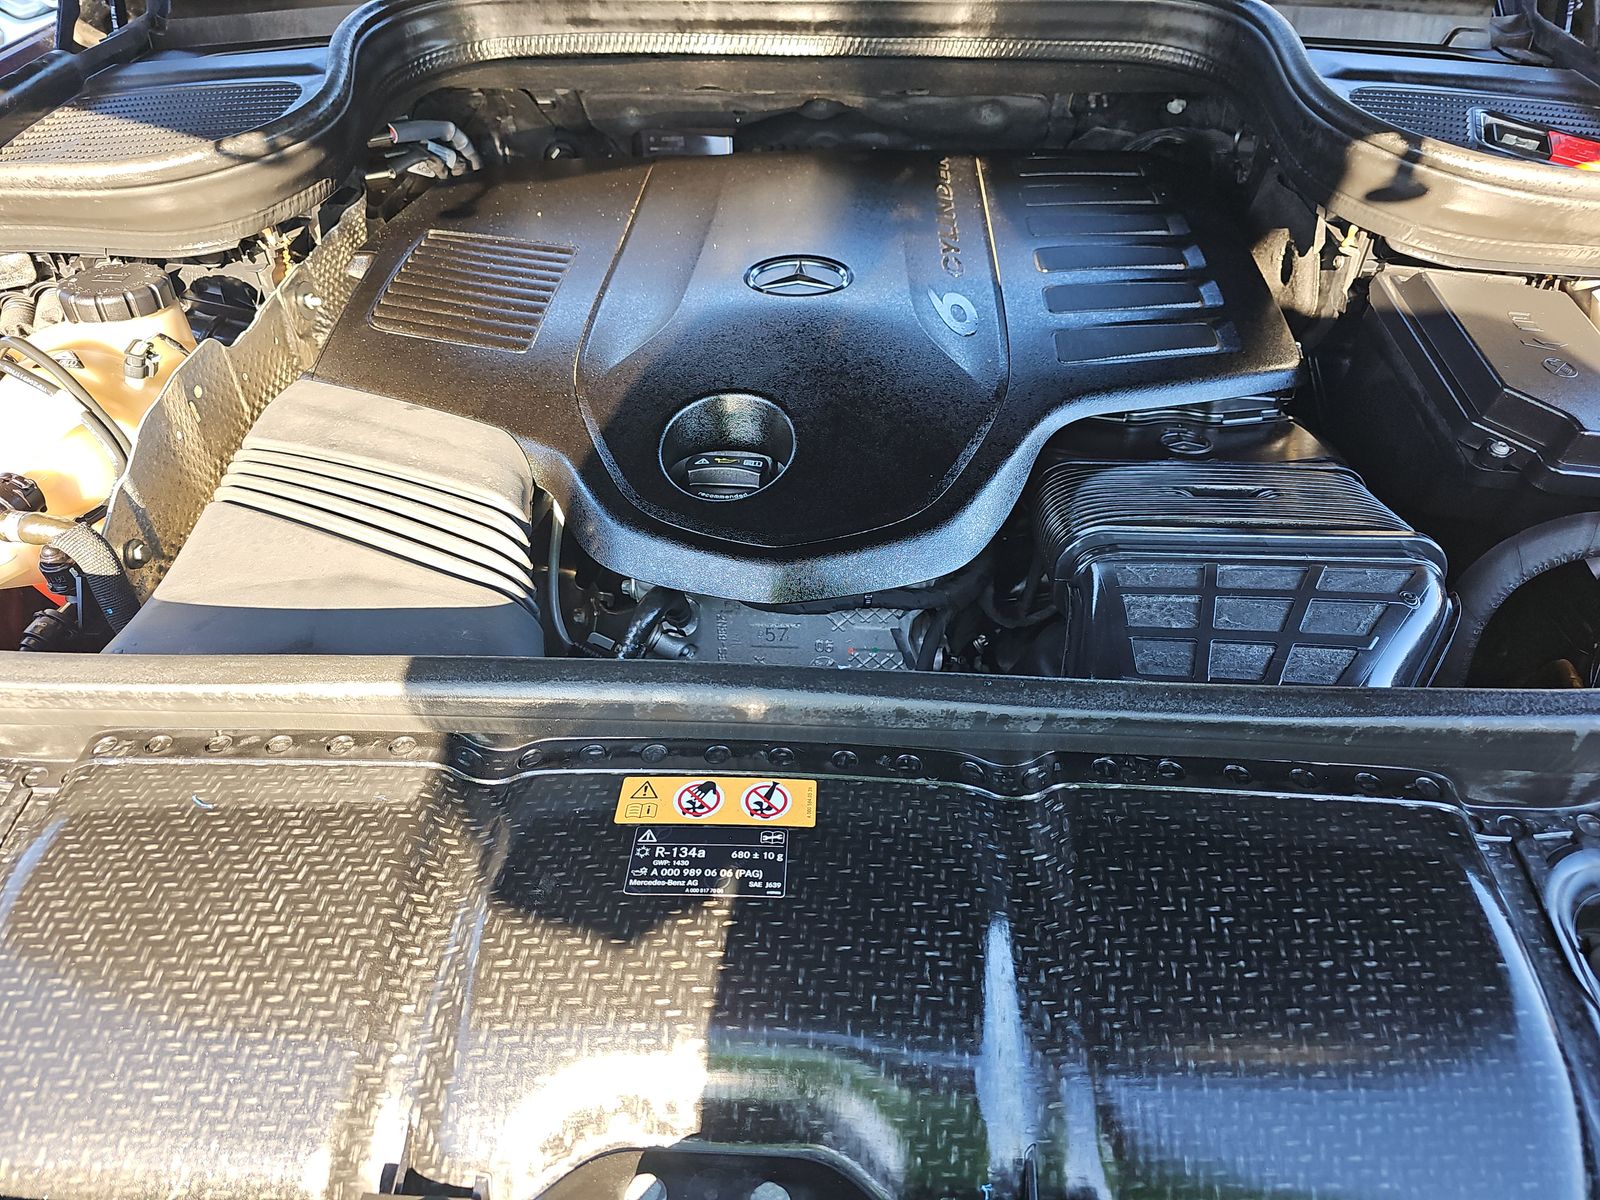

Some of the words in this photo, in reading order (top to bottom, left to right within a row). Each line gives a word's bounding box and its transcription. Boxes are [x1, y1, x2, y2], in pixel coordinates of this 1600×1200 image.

[927, 284, 979, 337] 6
[655, 846, 706, 858] R-134a
[731, 851, 751, 859] 680
[763, 852, 775, 860] 10
[776, 853, 784, 862] g
[650, 868, 659, 876] A
[660, 868, 681, 877] 000
[682, 868, 702, 877] 989
[704, 868, 718, 877] 06
[719, 869, 734, 878] 06
[734, 869, 763, 880] (PAG)
